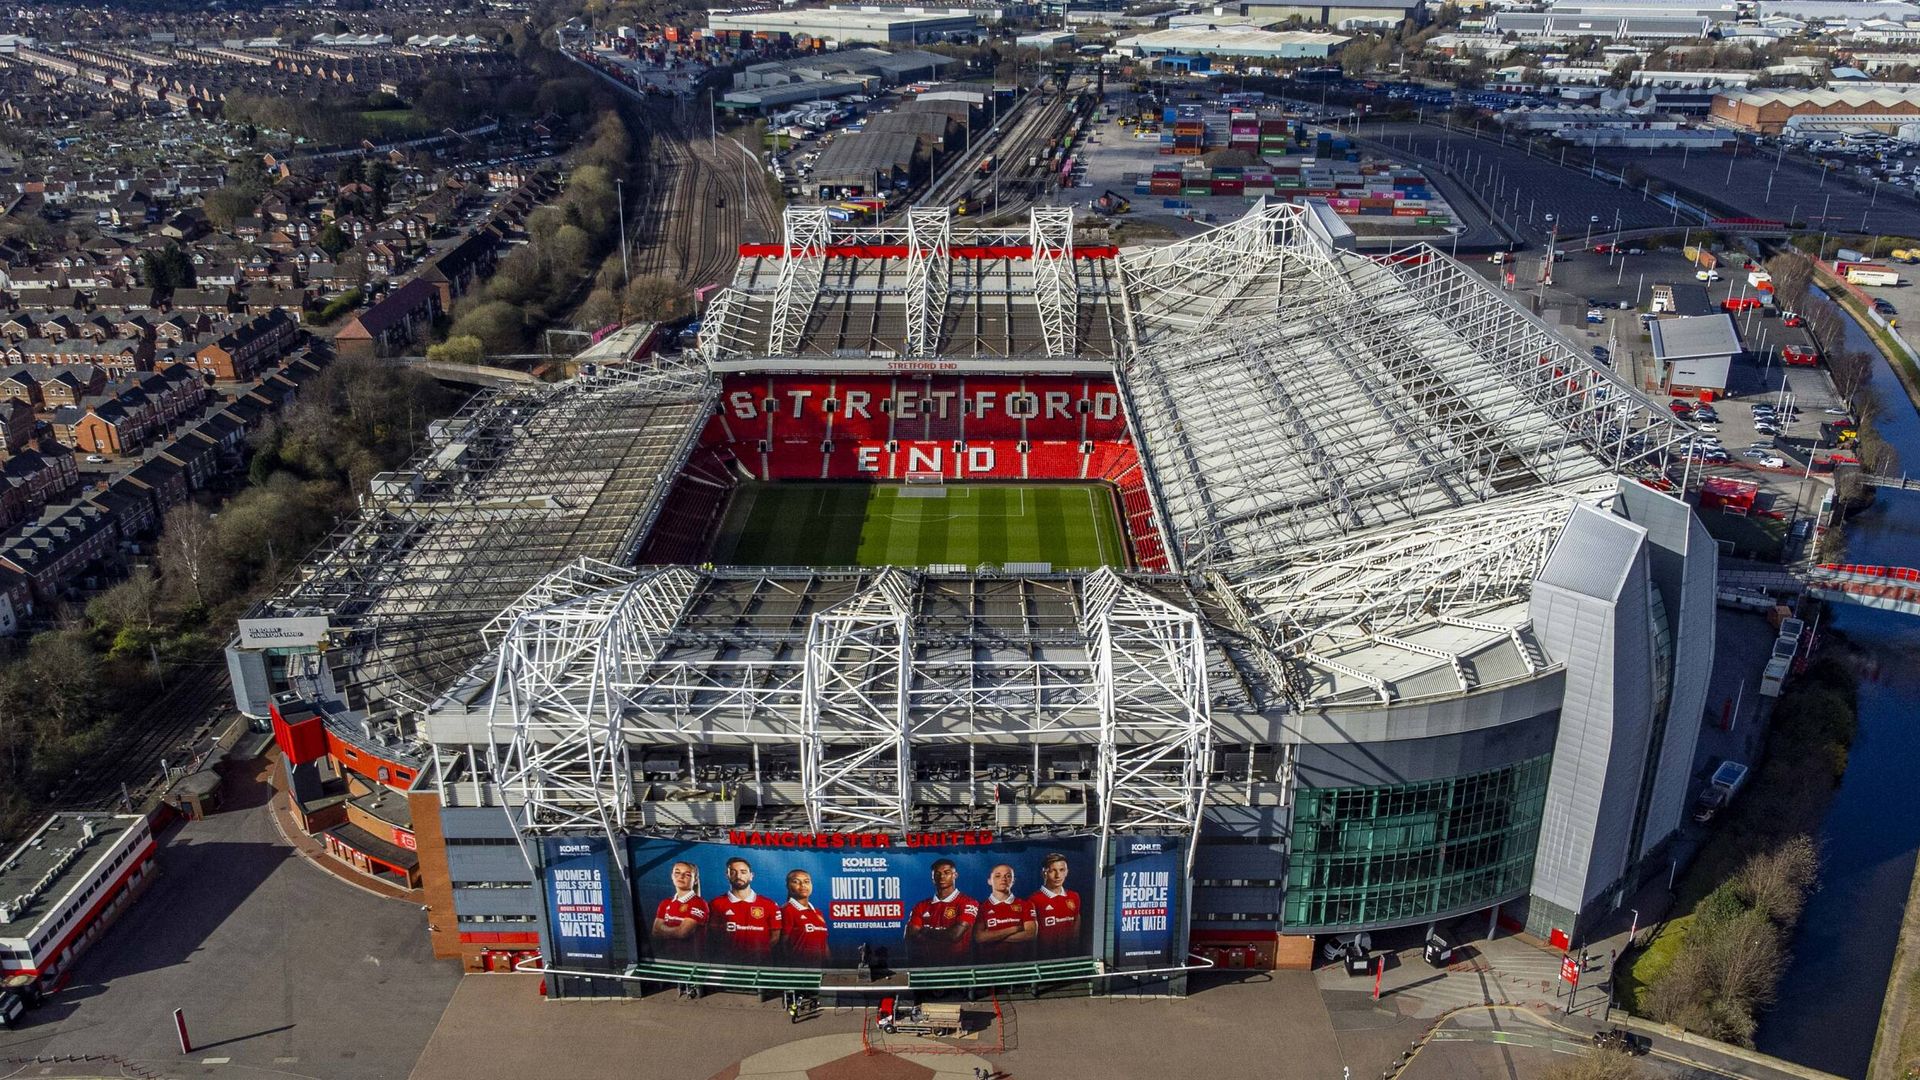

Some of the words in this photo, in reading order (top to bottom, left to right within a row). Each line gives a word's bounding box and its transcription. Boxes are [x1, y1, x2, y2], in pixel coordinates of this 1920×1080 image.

[730, 390, 1117, 420] STRETFORD
[858, 446, 995, 472] END
[729, 831, 890, 848] MANCHESTER
[905, 831, 993, 848] UNITED
[1131, 843, 1162, 851] KOHLER
[842, 857, 888, 867] KOHLER
[554, 869, 591, 881] WOMEN
[593, 869, 601, 880] &
[1122, 872, 1137, 888] 2.2
[1139, 872, 1169, 887] BILLION
[555, 880, 577, 890] GIRLS
[577, 881, 602, 890] SPEND
[831, 876, 874, 900] UNITED
[877, 876, 901, 900] FOR
[557, 890, 573, 905] 200
[573, 890, 603, 905] MILLION
[1122, 887, 1168, 902] PEOPLE
[559, 913, 604, 922] COLLECTING
[832, 904, 861, 917] SAFE
[863, 904, 901, 917] WATER
[560, 922, 605, 937] WATER
[1122, 916, 1140, 931] SAFE
[1142, 915, 1166, 931] WATER
